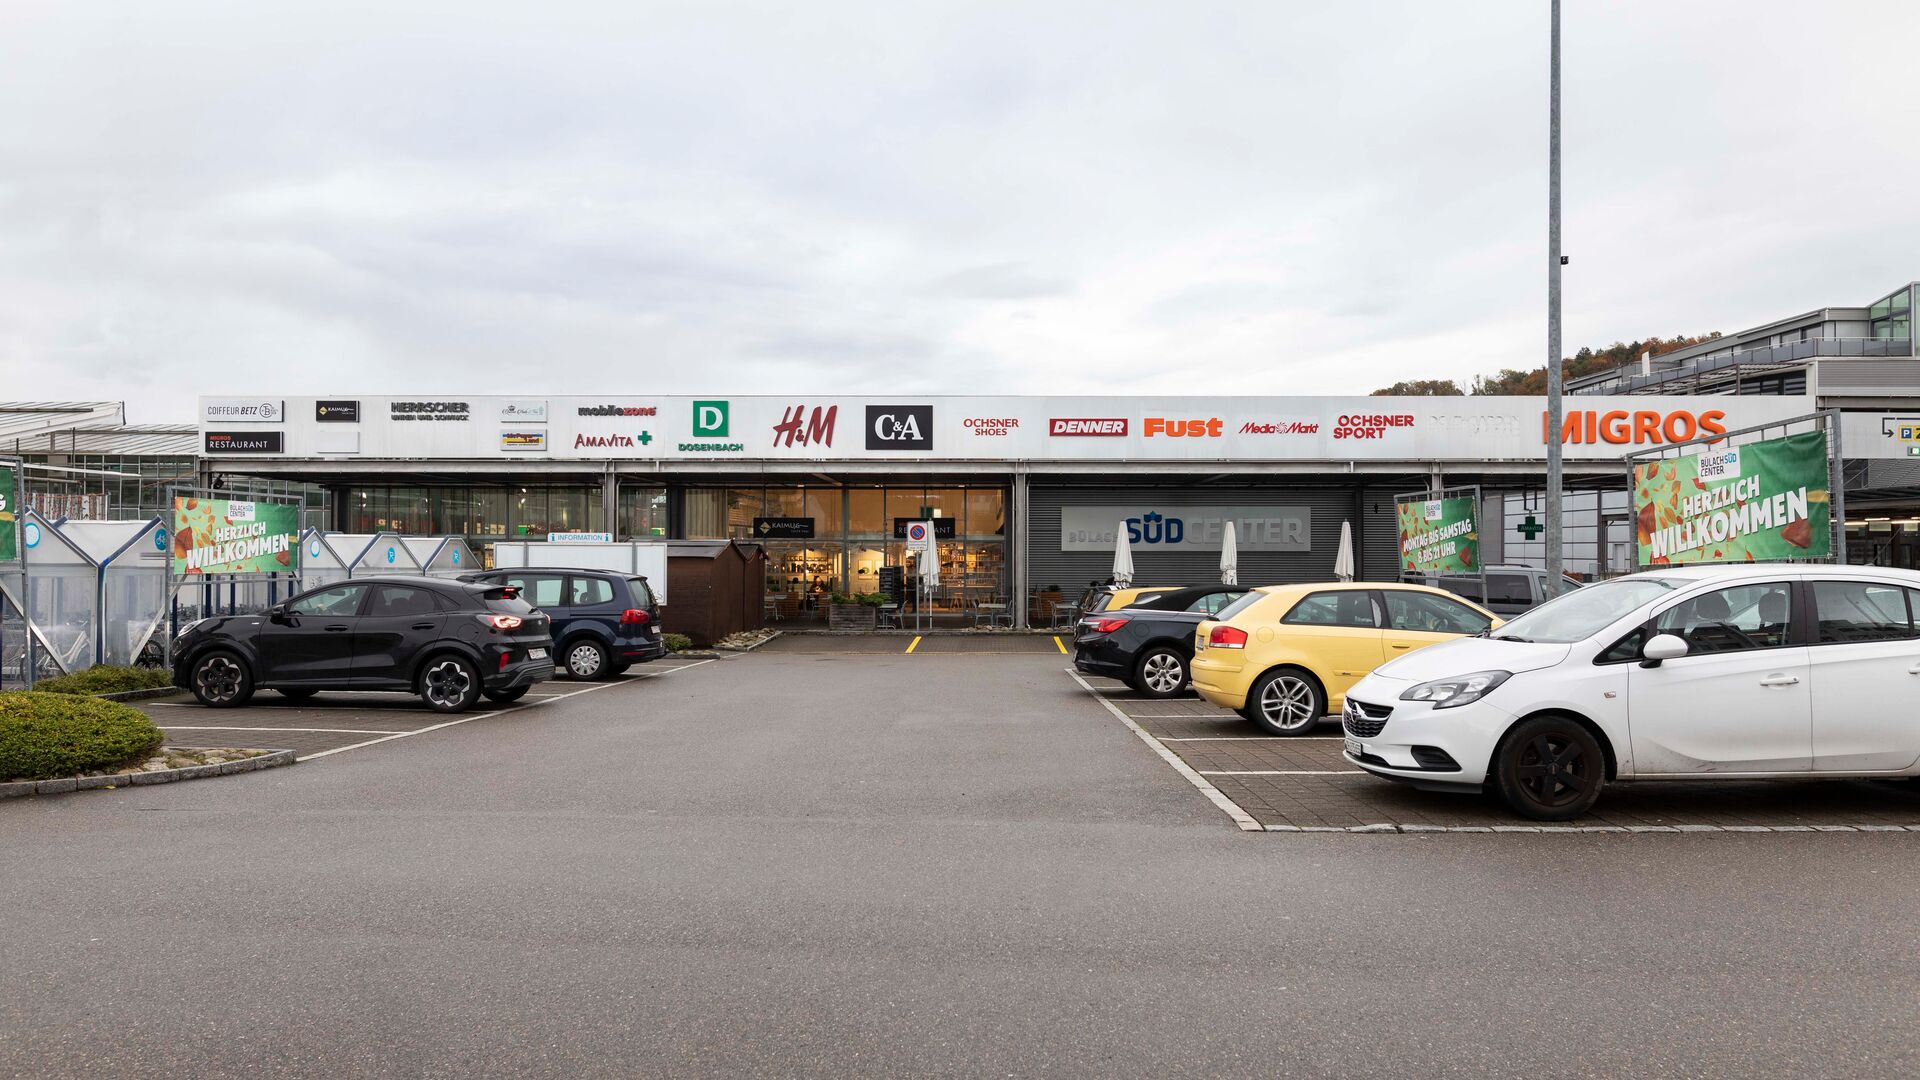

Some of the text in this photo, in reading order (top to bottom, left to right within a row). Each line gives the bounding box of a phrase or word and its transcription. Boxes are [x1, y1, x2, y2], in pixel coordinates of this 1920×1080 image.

[207, 406, 258, 415] COIFFEUR BETZ
[391, 402, 470, 413] HERRSCHER
[578, 404, 657, 417] mobilezone
[700, 406, 724, 431] D
[963, 418, 1019, 428] OCHSNER
[1338, 415, 1414, 427] OCHSNER
[773, 405, 838, 448] H&M
[874, 414, 924, 441] C&A
[974, 428, 1007, 436] SHOES
[1053, 420, 1124, 434] DENNER
[1143, 417, 1223, 437] Fust
[1239, 422, 1319, 434] Media Markt
[1333, 427, 1386, 439] SPORT
[1543, 410, 1727, 445] MIGROS
[209, 440, 268, 449] RESTAURANT
[574, 433, 634, 449] AMAVITA
[678, 443, 744, 452] DOSENBACH
[1700, 465, 1724, 477] CENTER
[1682, 474, 1760, 518] HERZLICH
[1650, 486, 1808, 558] WILLKOMMEN
[216, 522, 266, 542] HERZLICH
[1403, 518, 1472, 552] MONTAG BIS SAMSTAG
[186, 533, 289, 569] WILLKOMMEN
[1424, 547, 1433, 562] BIS
[1441, 541, 1456, 557] UHR
